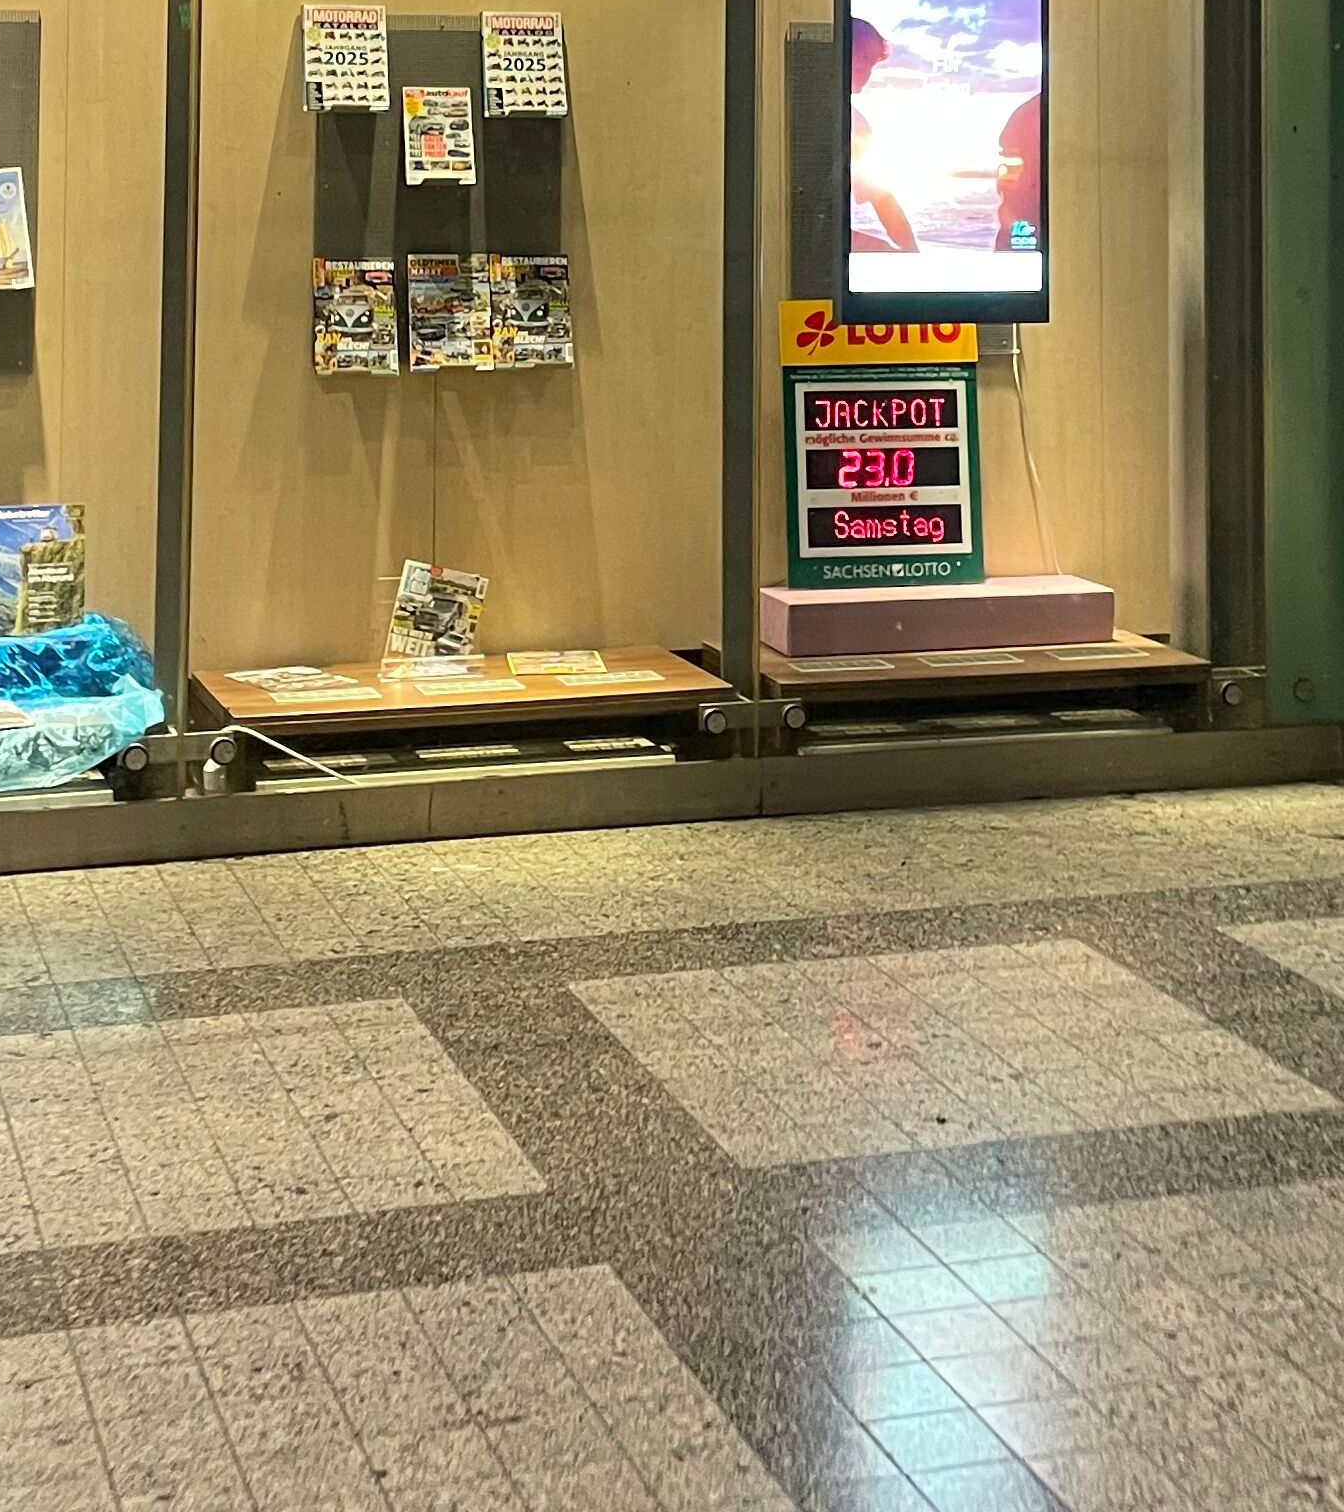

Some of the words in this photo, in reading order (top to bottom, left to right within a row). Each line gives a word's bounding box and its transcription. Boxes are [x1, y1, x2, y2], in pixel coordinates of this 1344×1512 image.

[313, 10, 377, 23] MOTORRAD
[492, 17, 553, 30] MOTORRAD
[324, 52, 369, 65] 2025
[503, 58, 546, 71] 2025
[325, 261, 395, 271] RESTAURIEREN
[409, 259, 457, 267] OLDTIMER
[501, 256, 568, 266] RESTAURIEREN
[410, 268, 442, 276] MARKT
[815, 398, 945, 428] JACKPOT
[806, 433, 856, 447] mögliche
[859, 432, 941, 444] Gewinnsumme
[851, 492, 906, 503] Millionen
[909, 491, 919, 501] €
[834, 509, 945, 543] Samstag
[823, 563, 891, 579] SACHSEN
[905, 561, 952, 576] LOTTO
